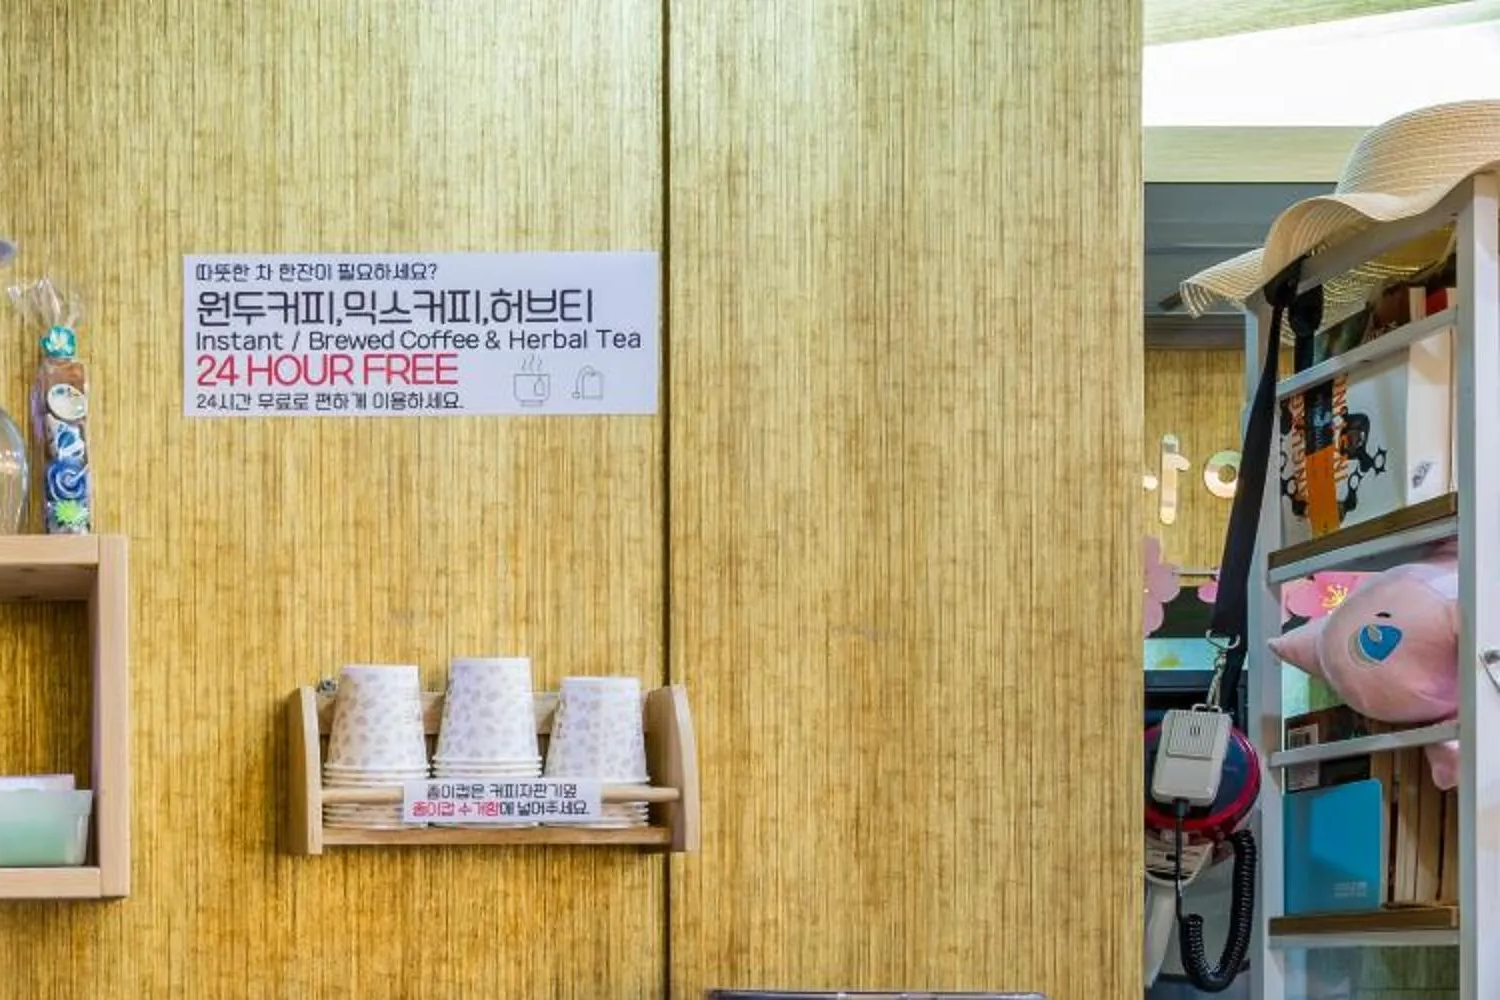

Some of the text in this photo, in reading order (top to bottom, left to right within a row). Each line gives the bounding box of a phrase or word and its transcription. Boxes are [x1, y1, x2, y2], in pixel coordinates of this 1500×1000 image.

[195, 263, 437, 282] 따뜻한 차 한잔이 필요하세요?
[196, 329, 642, 351] Instant / Brewed Coffee & Herbal Tea
[197, 354, 458, 386] 24 HOUR FREE
[196, 394, 252, 411] 24시간
[258, 393, 310, 411] 무료로
[315, 393, 368, 411] 편하게
[427, 783, 485, 799] 종이컵은
[412, 800, 456, 817] 종이컵
